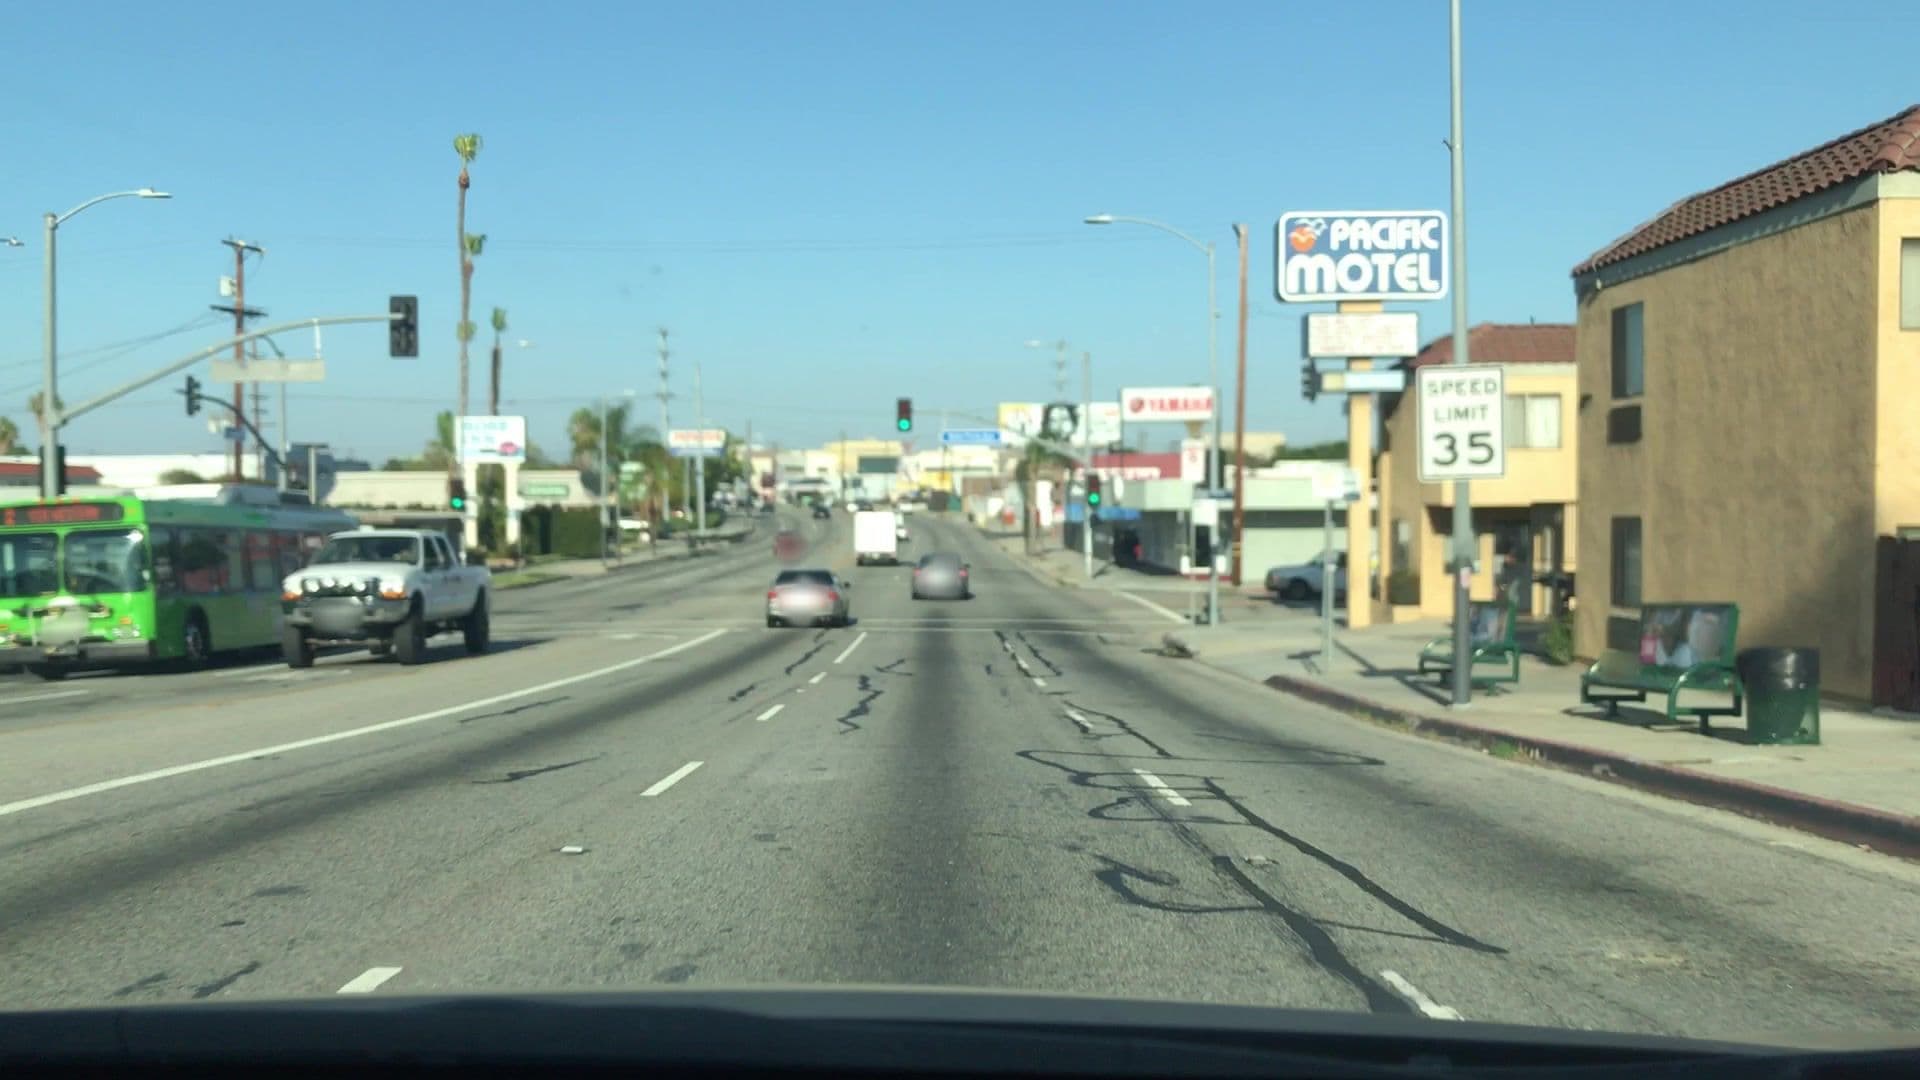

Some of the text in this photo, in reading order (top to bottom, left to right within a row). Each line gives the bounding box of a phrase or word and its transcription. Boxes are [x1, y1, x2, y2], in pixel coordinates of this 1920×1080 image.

[1329, 218, 1440, 251] PACIFIC
[1286, 253, 1440, 293] MOTEL
[1427, 377, 1498, 398] SPEED
[1433, 405, 1489, 422] LIMIT
[1432, 431, 1495, 467] 35
